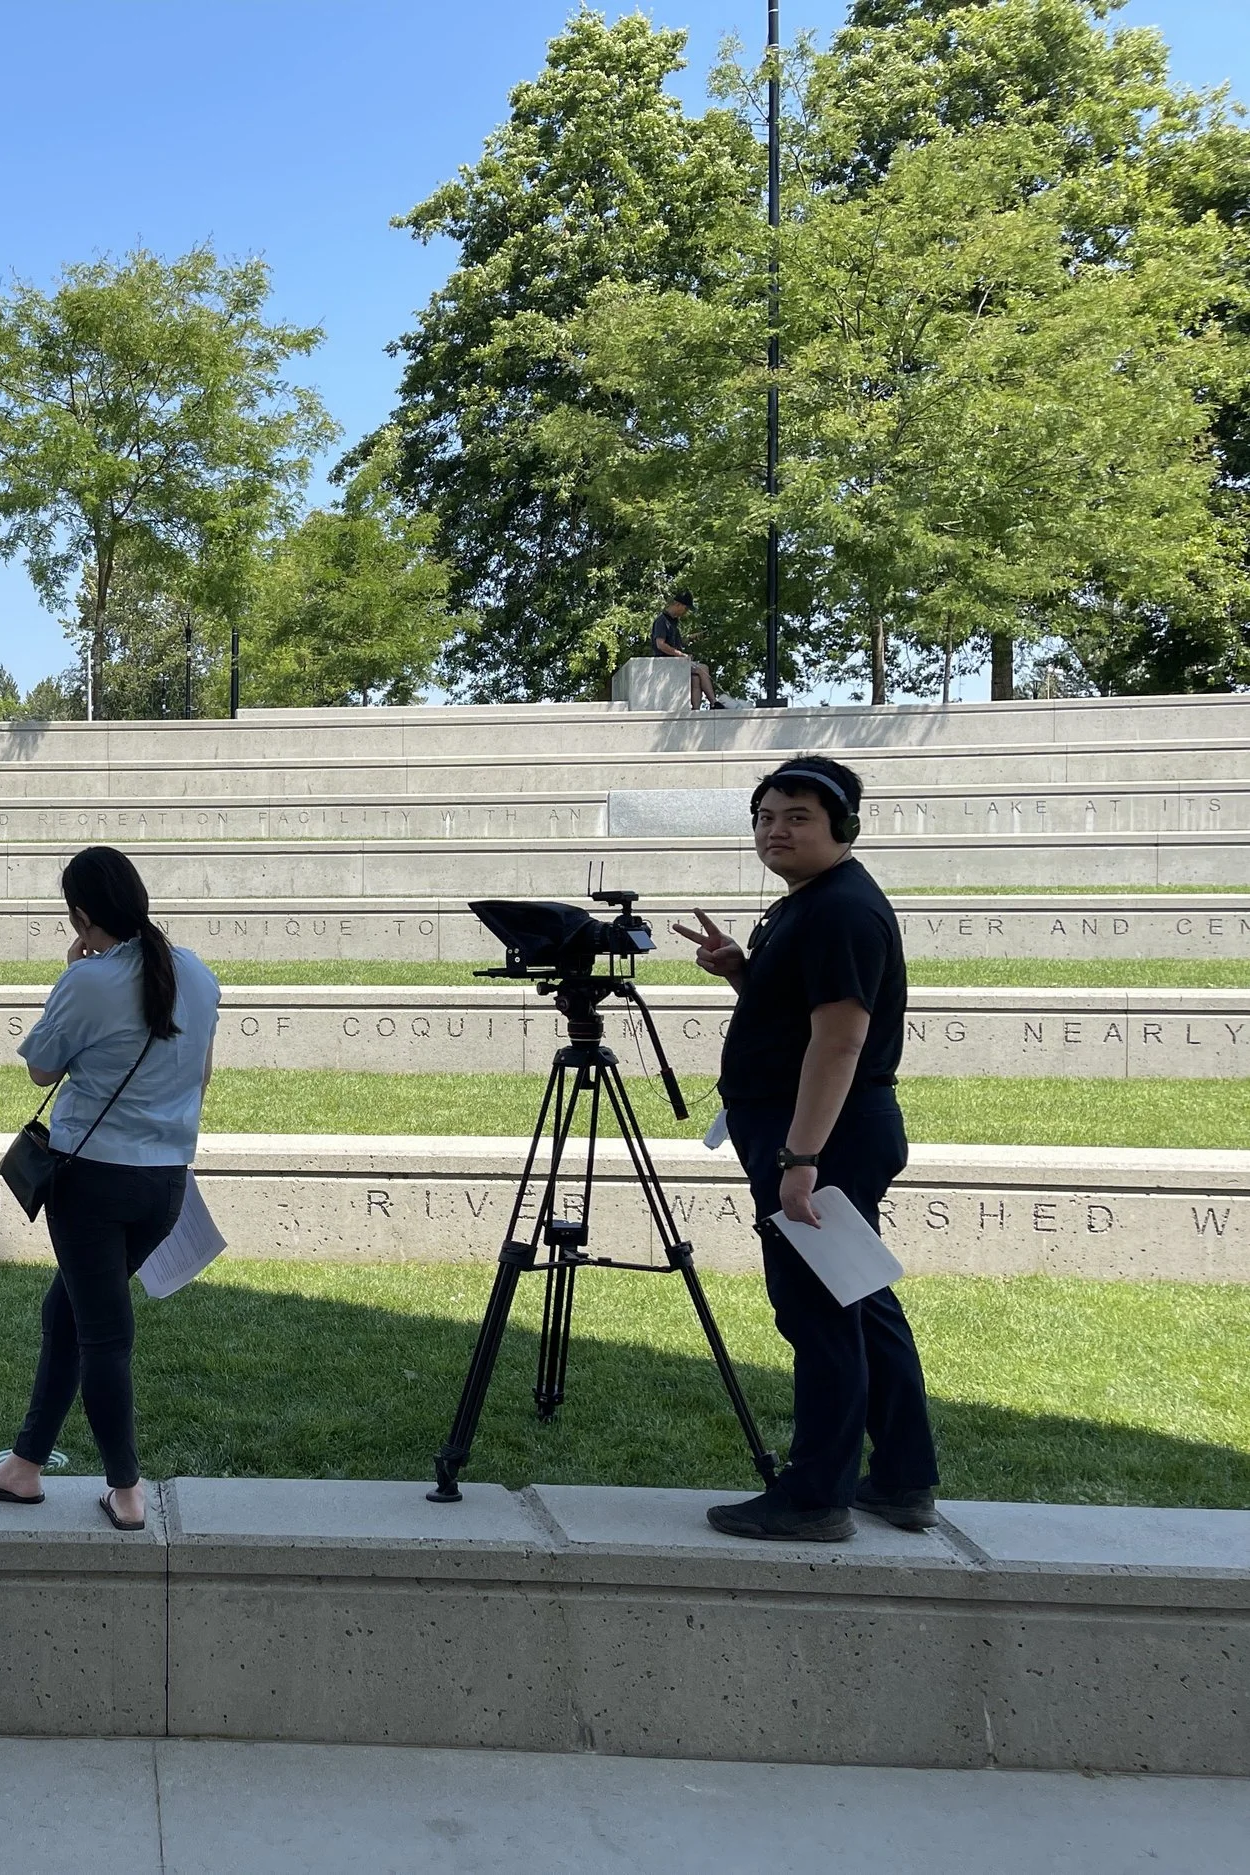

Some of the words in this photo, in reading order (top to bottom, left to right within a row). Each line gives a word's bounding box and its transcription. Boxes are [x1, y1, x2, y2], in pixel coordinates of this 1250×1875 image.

[38, 811, 228, 827] RECREATION
[258, 810, 411, 825] FACILITY
[441, 809, 517, 823] WITH
[549, 808, 581, 821] AN
[869, 803, 927, 818] BAN
[964, 800, 1047, 816] LAKE
[1084, 799, 1121, 814] AT
[1163, 798, 1221, 813] ITS
[208, 920, 352, 937] UNIQUE
[392, 920, 434, 936] TO
[903, 918, 1004, 936] IVER
[1050, 918, 1130, 936] AND
[240, 1016, 291, 1037] OF
[342, 1016, 644, 1039] COQUITLM
[1023, 1021, 1245, 1045] NEARLY
